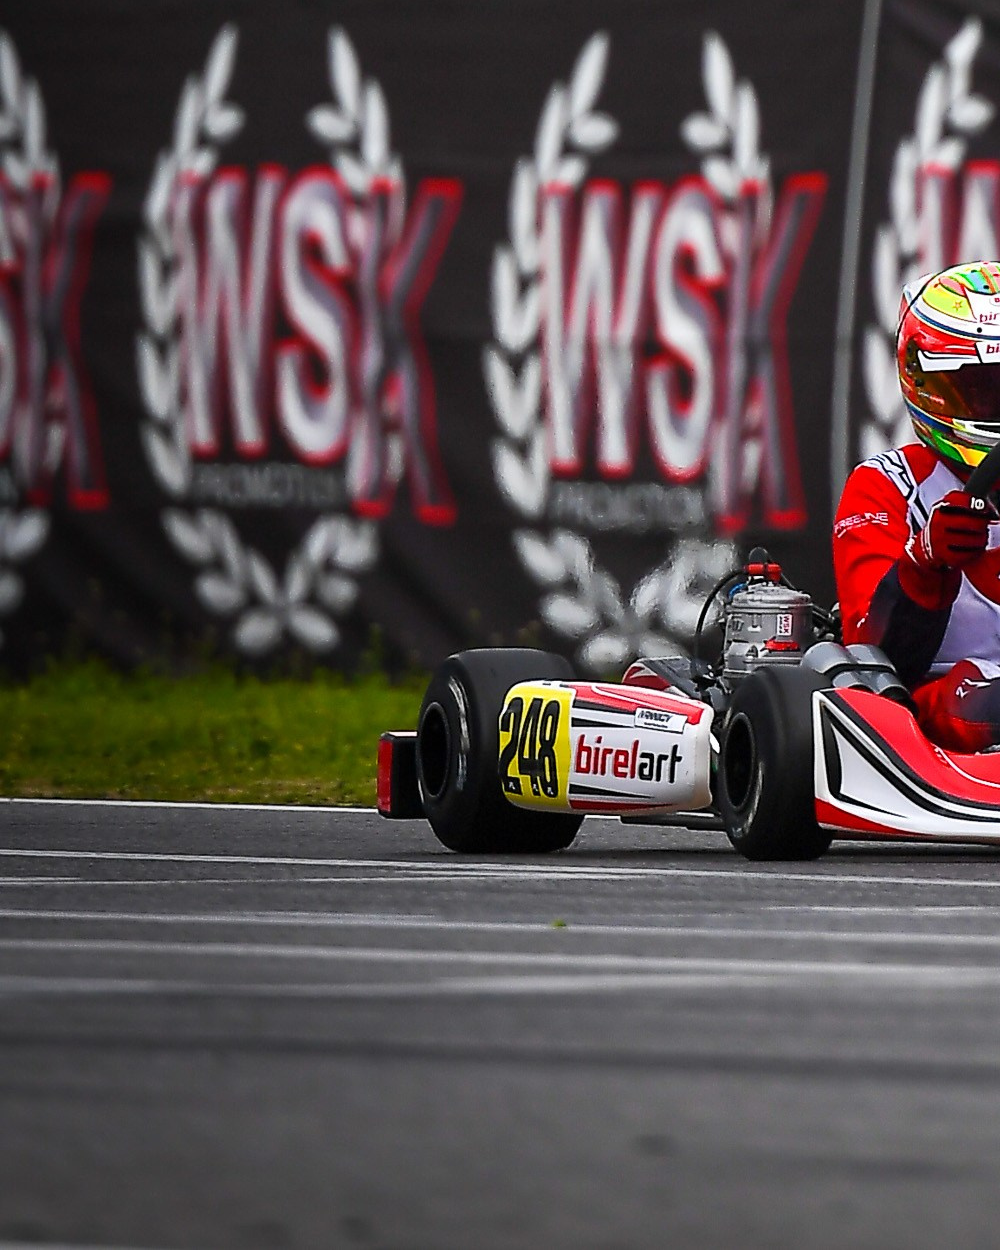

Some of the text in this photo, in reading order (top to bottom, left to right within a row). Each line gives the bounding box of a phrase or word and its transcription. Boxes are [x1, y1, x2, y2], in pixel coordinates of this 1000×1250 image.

[172, 162, 464, 526] WSK
[539, 171, 828, 533] WSK
[500, 697, 561, 798] 248
[575, 734, 683, 784] birelart
